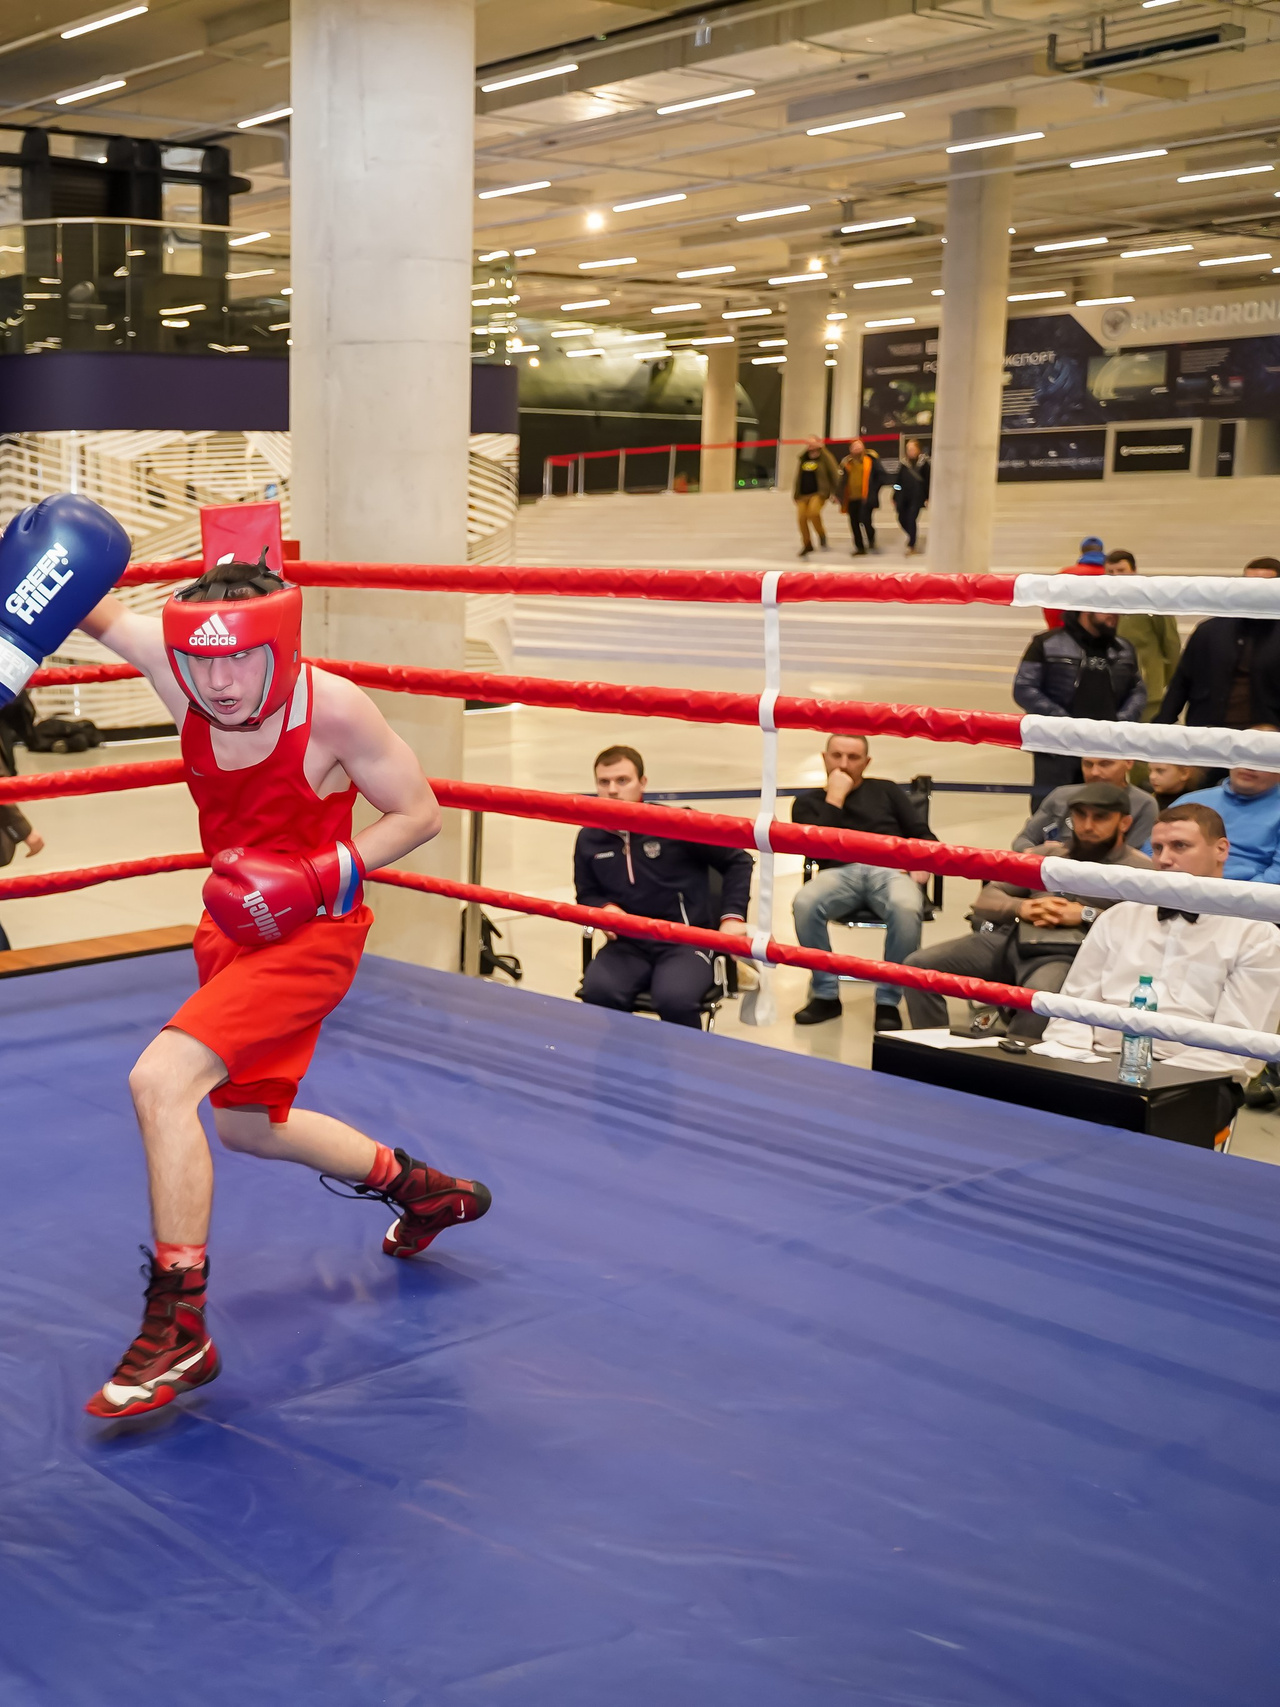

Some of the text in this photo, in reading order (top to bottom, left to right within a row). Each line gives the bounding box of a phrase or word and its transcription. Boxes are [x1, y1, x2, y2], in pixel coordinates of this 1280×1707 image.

[1132, 299, 1280, 332] ROSOBORON
[5, 542, 69, 614] GREEN
[16, 569, 74, 625] HILL
[188, 633, 237, 646] adidas
